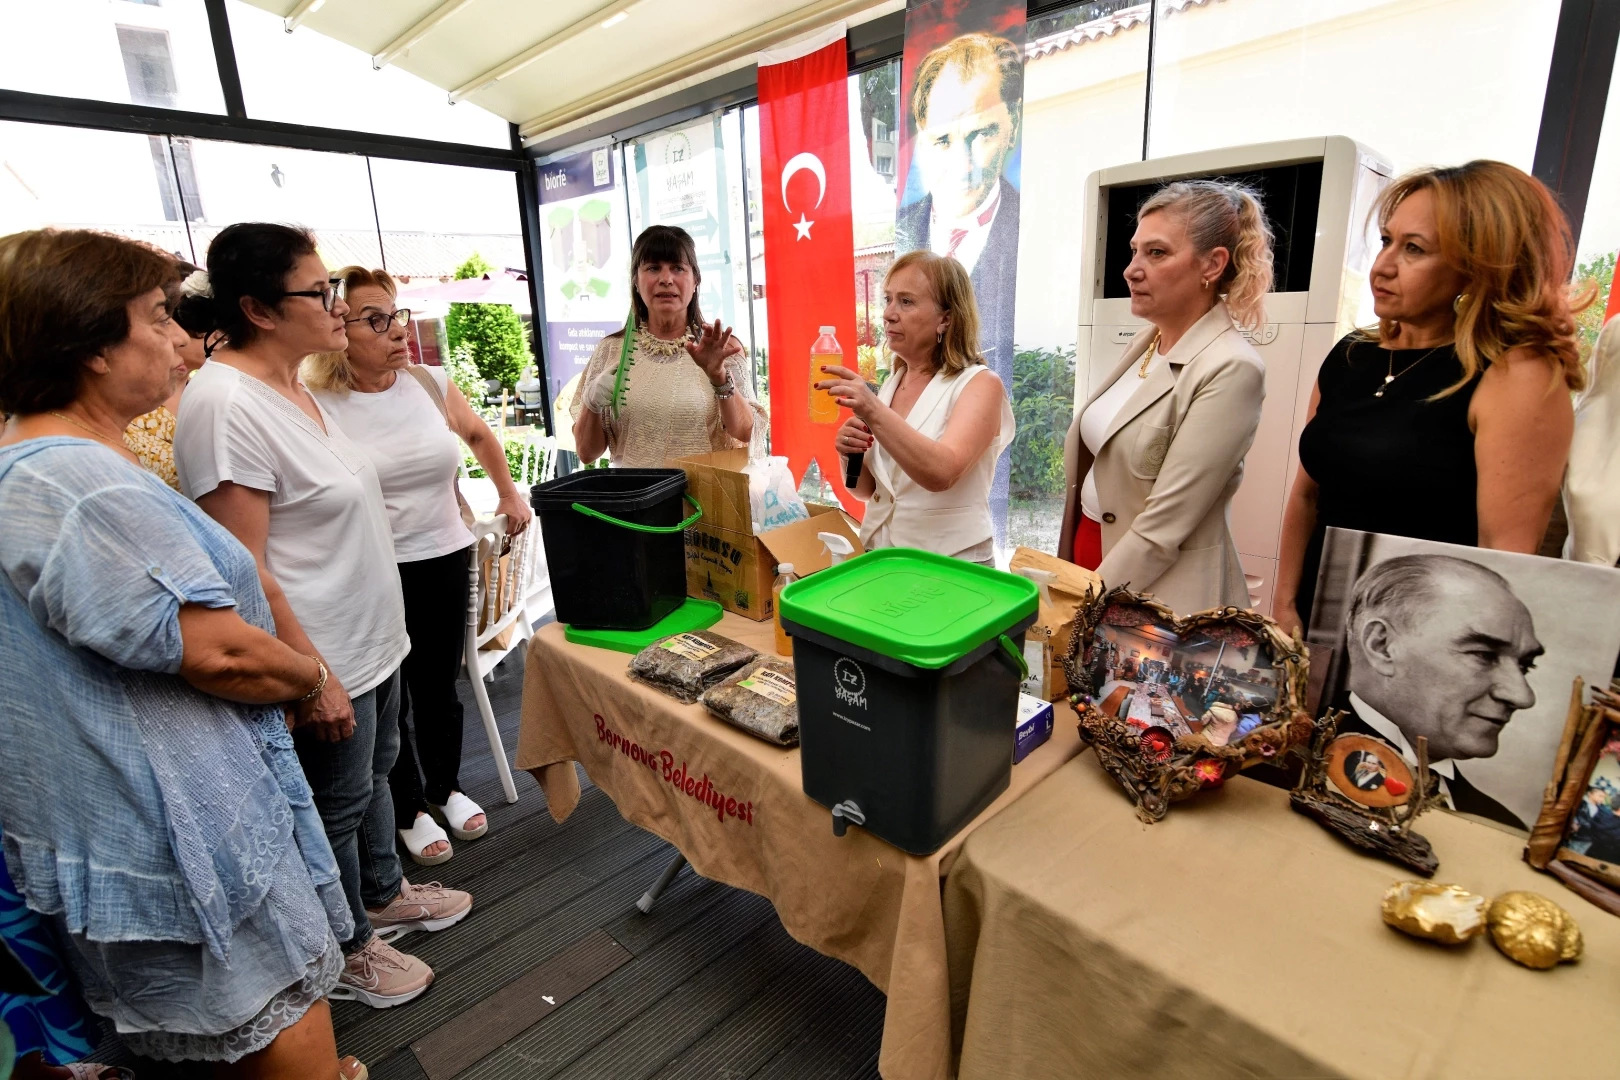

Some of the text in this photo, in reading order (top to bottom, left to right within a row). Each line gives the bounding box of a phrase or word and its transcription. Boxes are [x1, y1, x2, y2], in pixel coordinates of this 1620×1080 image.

[834, 686, 868, 711] YAŞAM
[593, 713, 753, 826] Bornova Belediyesi
